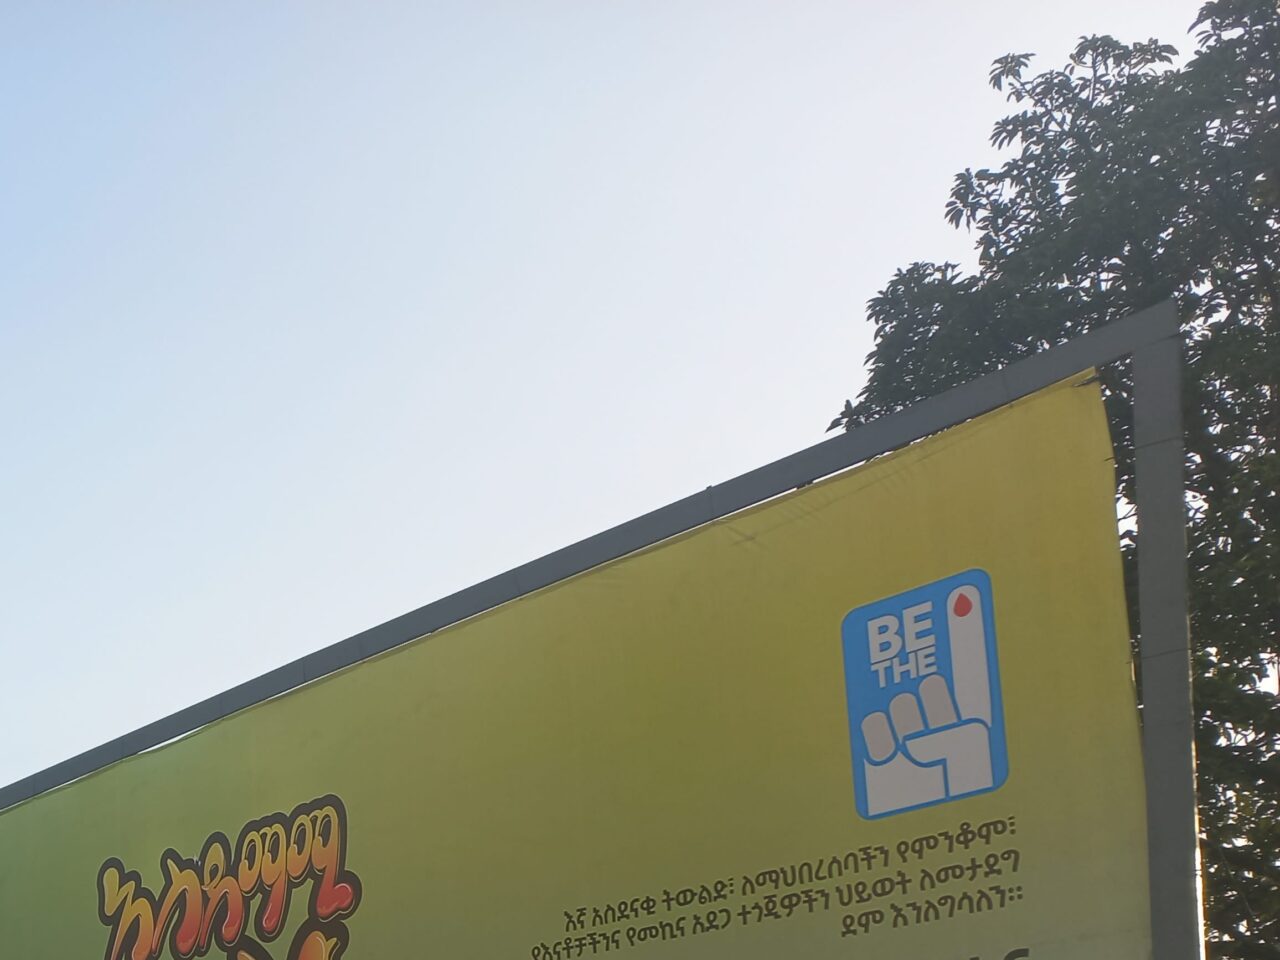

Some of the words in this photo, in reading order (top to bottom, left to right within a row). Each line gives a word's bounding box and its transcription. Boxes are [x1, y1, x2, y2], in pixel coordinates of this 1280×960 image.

[867, 600, 936, 665] BE
[870, 645, 938, 688] THE
[563, 906, 587, 932] እኛ
[591, 895, 657, 927] አስደናቂ
[626, 917, 686, 946] የመኪና
[692, 908, 732, 935] አደጋ
[835, 870, 912, 907] ህይወት
[919, 848, 1021, 891] ለመታደግ
[840, 908, 885, 937] ደም
